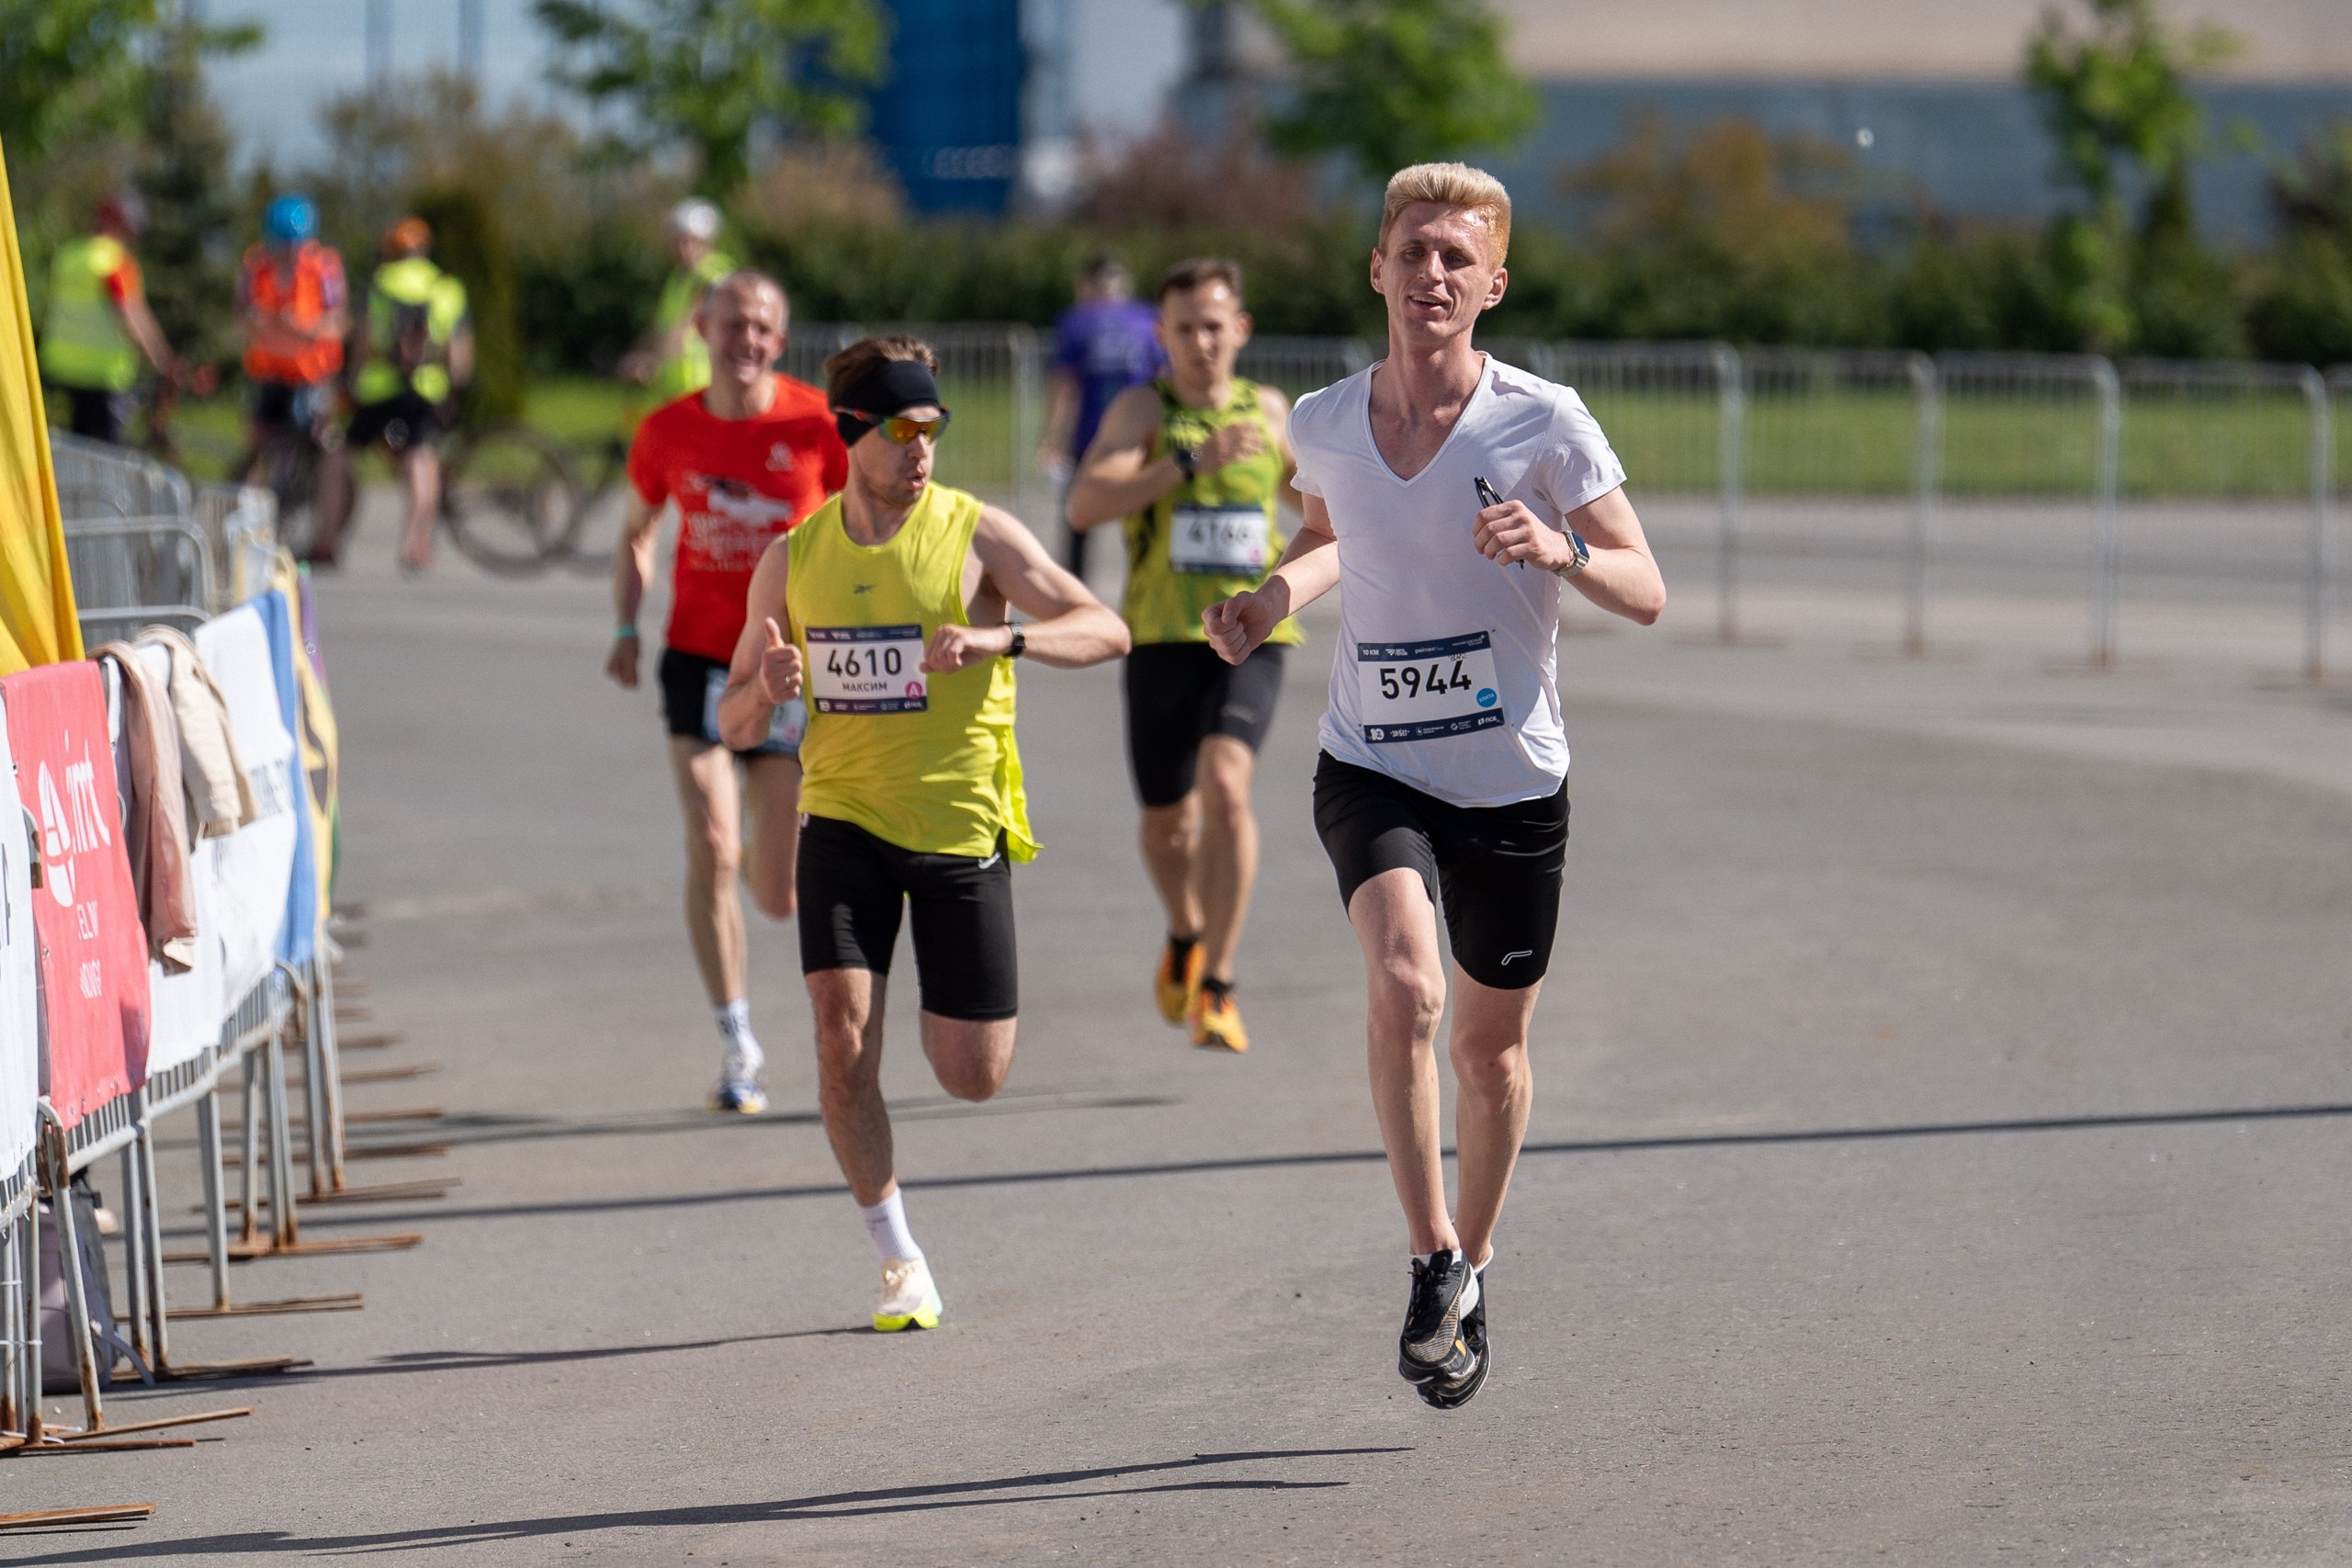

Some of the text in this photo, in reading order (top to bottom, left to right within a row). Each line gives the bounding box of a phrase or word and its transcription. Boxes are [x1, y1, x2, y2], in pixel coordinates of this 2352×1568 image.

[827, 648, 901, 677] 4610
[842, 681, 888, 693] МАКСИМ
[1379, 660, 1472, 700] 5944
